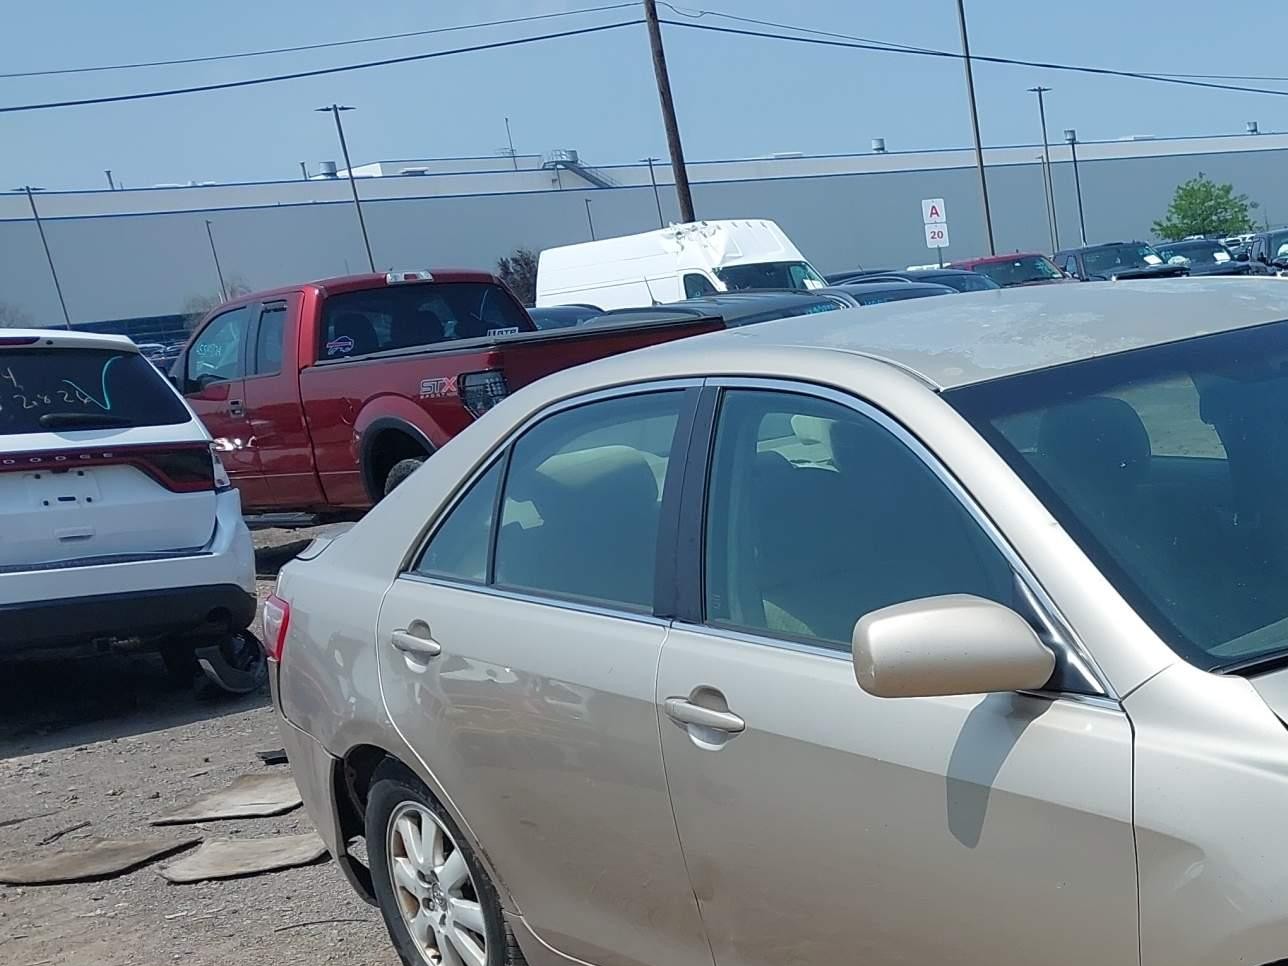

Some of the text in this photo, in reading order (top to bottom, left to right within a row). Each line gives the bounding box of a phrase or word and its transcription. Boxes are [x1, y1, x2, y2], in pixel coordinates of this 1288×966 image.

[929, 205, 940, 218] A
[930, 230, 944, 240] 20
[420, 376, 458, 395] STX
[3, 452, 113, 464] DODGE
